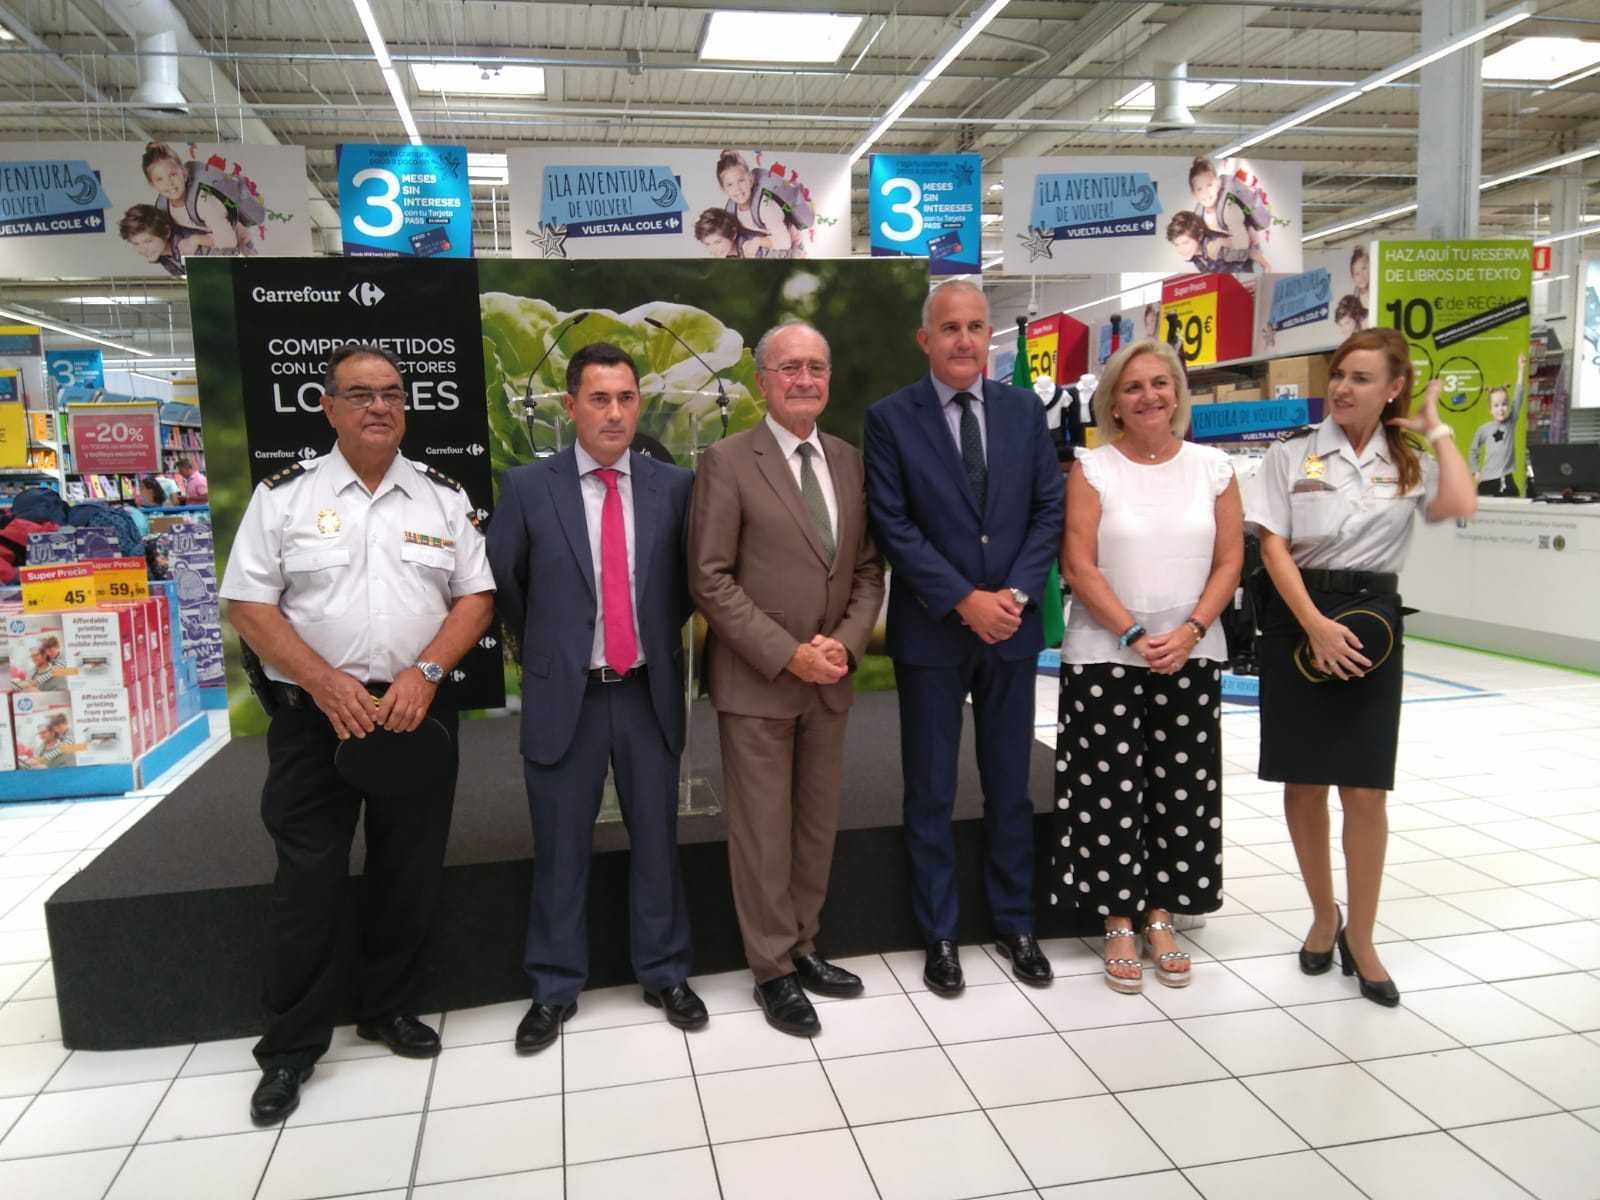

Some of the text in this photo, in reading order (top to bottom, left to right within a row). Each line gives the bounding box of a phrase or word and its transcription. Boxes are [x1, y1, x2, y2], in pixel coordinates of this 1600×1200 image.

[0, 164, 74, 193] ENTURA
[402, 174, 437, 184] MESES
[577, 167, 658, 196] AVENTURA
[402, 186, 420, 195] SIN
[923, 183, 953, 191] MESES
[1065, 175, 1136, 202] AVENTURA
[352, 168, 404, 237] 3
[403, 198, 461, 208] INTERESES
[923, 194, 938, 202] SIN
[568, 195, 633, 218] DE VOLVER!
[880, 177, 923, 242] 3
[923, 204, 973, 213] INTERESES
[1056, 201, 1114, 222] DE VOLVER!
[429, 210, 453, 218] Tarjeta
[35, 222, 49, 232] AL
[50, 219, 82, 230] COLE
[582, 220, 663, 235] VUELTA AL COLE
[1067, 223, 1139, 238] VUELTA AL COLE
[1385, 245, 1529, 262] HAZ AQUÍ TU RESERVA
[1385, 268, 1521, 282] DE LIBROS DE TEXTO
[252, 286, 342, 303] Carrefour
[1446, 297, 1464, 310] de
[1466, 296, 1516, 310] REGA
[52, 360, 75, 386] 3
[271, 361, 457, 375] CON LO CTORES
[1443, 375, 1457, 392] 3
[273, 381, 460, 414] LOES
[85, 422, 144, 442] -20%
[255, 450, 295, 459] Carrefour
[425, 446, 464, 455] Carrefour
[113, 560, 140, 568] Precio
[27, 567, 87, 581] Super Precio
[64, 590, 85, 604] 45
